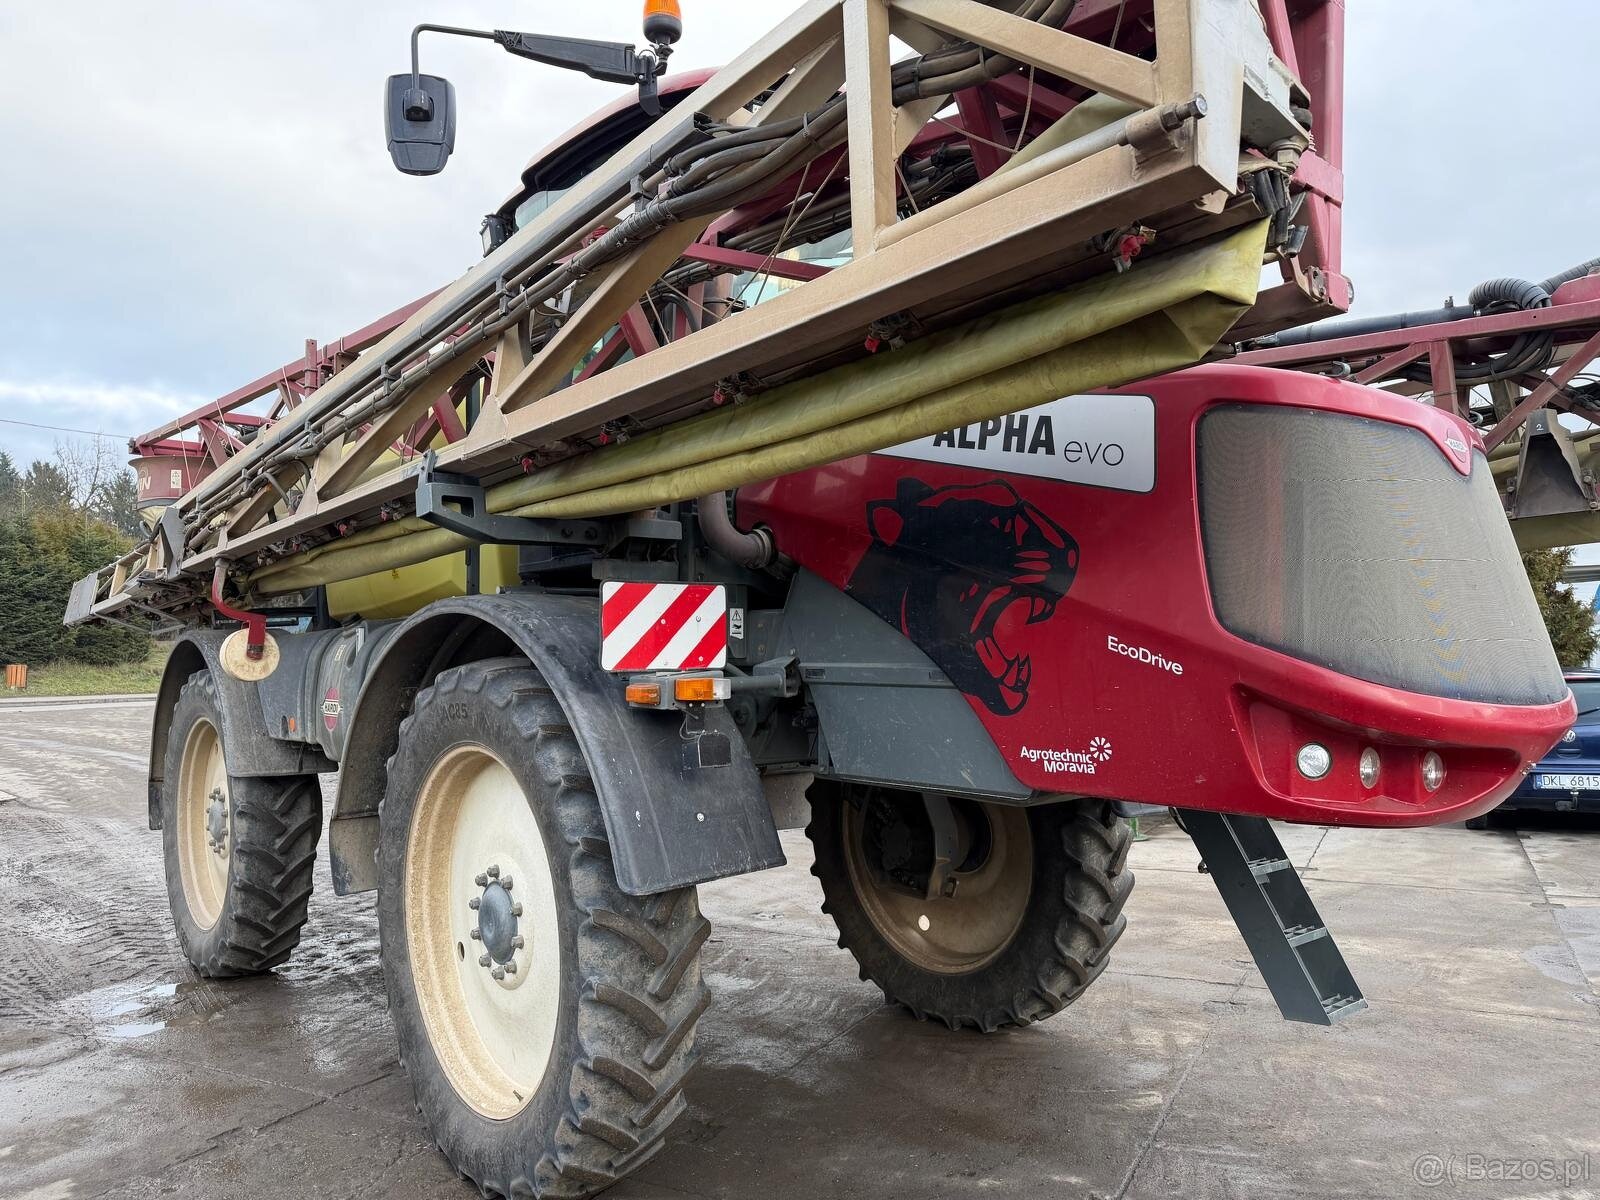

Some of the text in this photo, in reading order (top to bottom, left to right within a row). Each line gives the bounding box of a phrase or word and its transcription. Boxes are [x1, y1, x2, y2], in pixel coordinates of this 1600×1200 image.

[932, 413, 1124, 466] ALPHA evo
[1107, 635, 1183, 675] EcoDrive
[1020, 745, 1093, 764] Agrotechnic
[1043, 760, 1096, 775] Moravia
[1542, 775, 1566, 787] DKL
